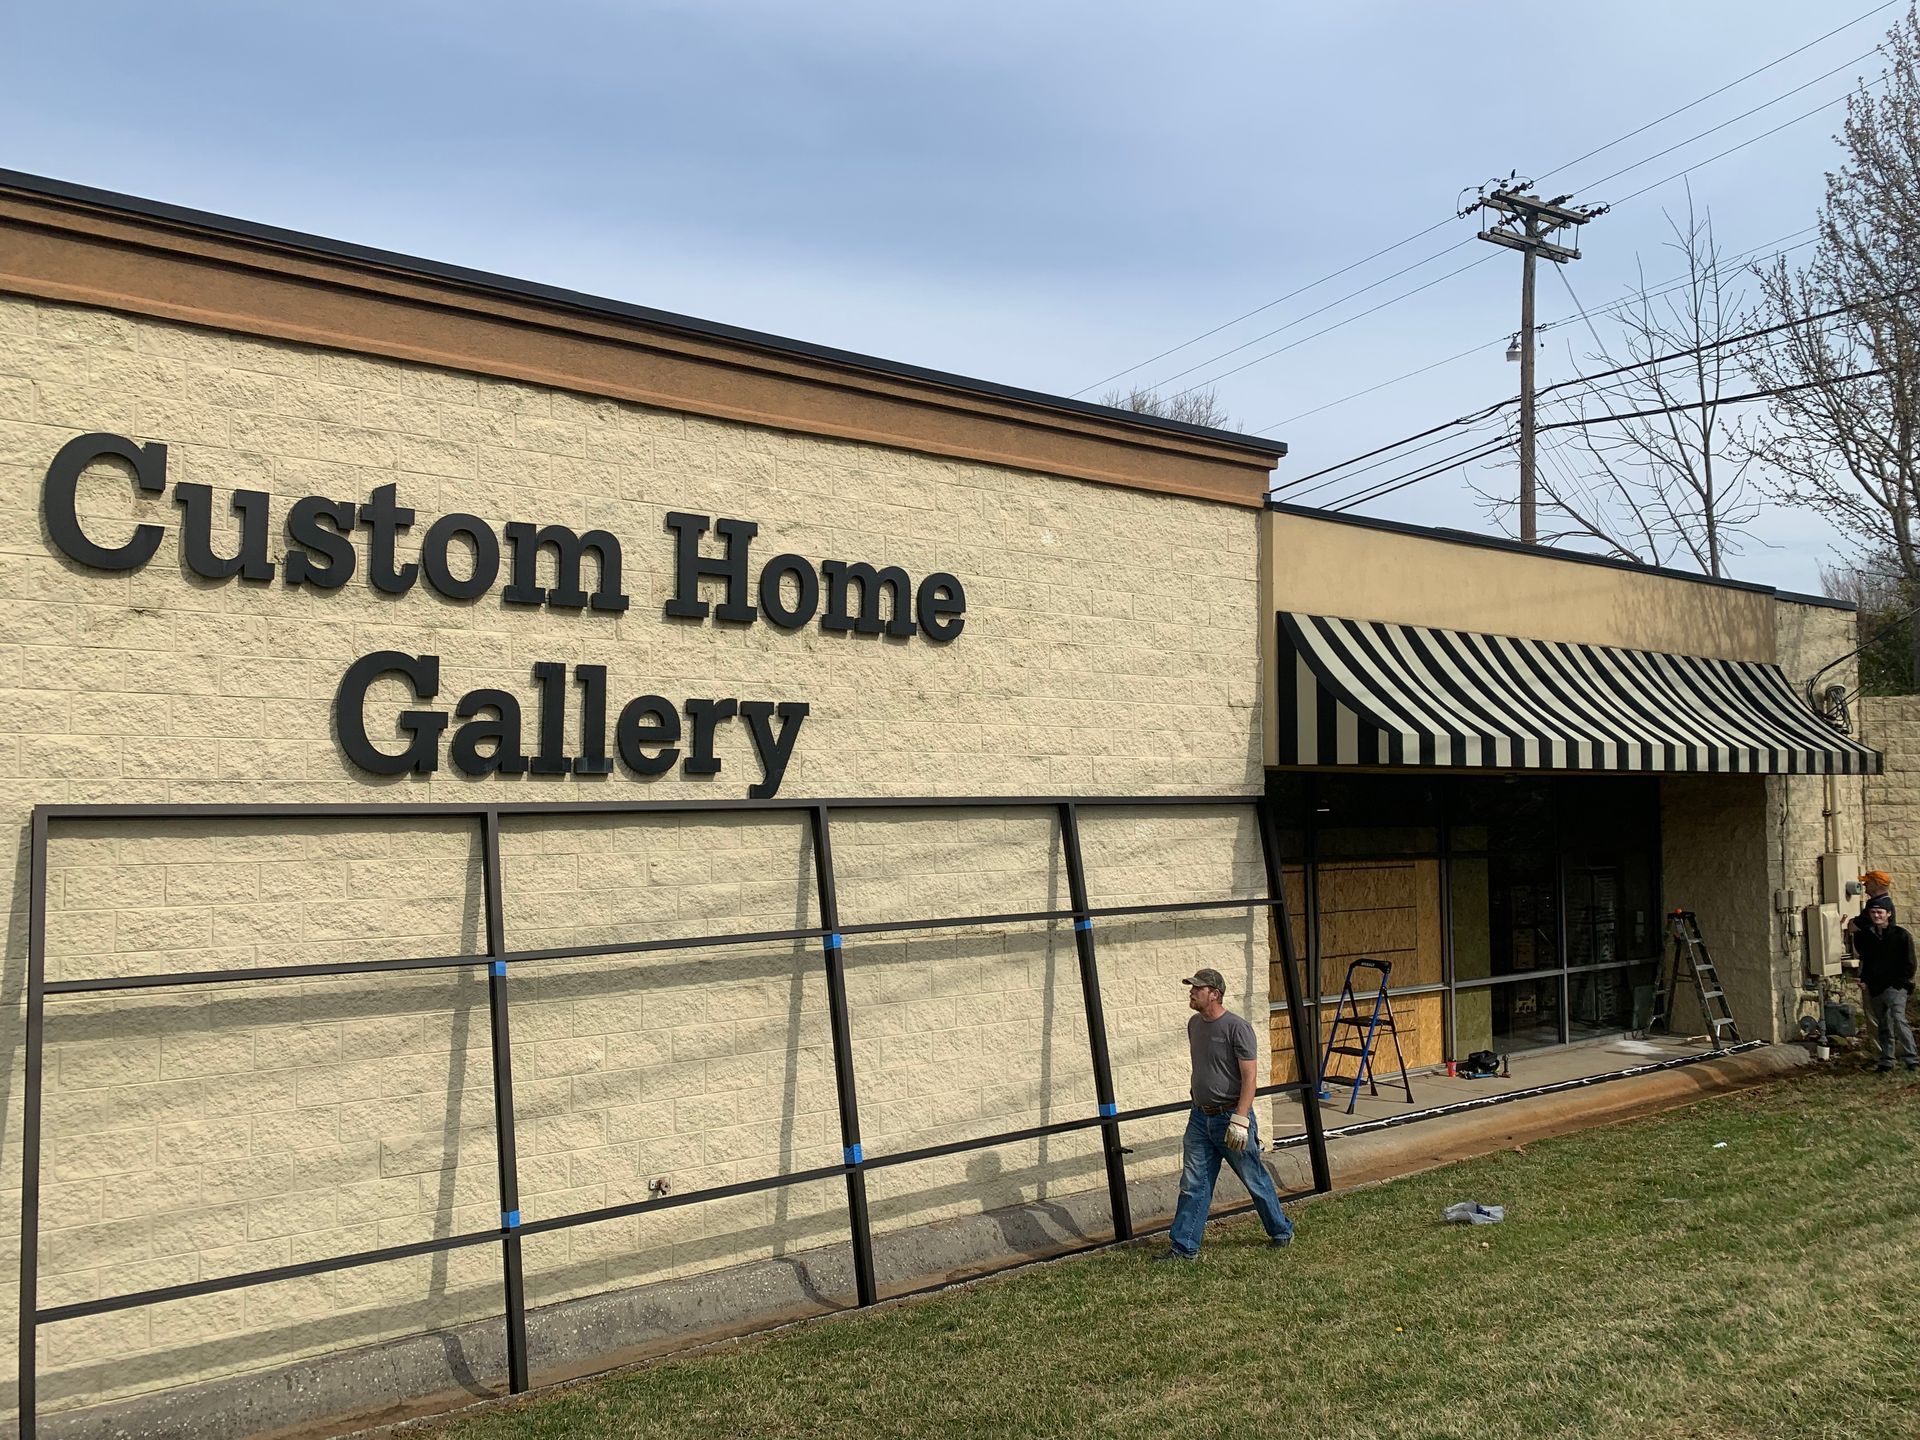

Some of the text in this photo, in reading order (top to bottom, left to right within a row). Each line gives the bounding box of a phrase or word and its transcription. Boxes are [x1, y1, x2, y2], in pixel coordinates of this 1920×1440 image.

[43, 432, 966, 641] Custom Home
[334, 650, 810, 799] Gallery
